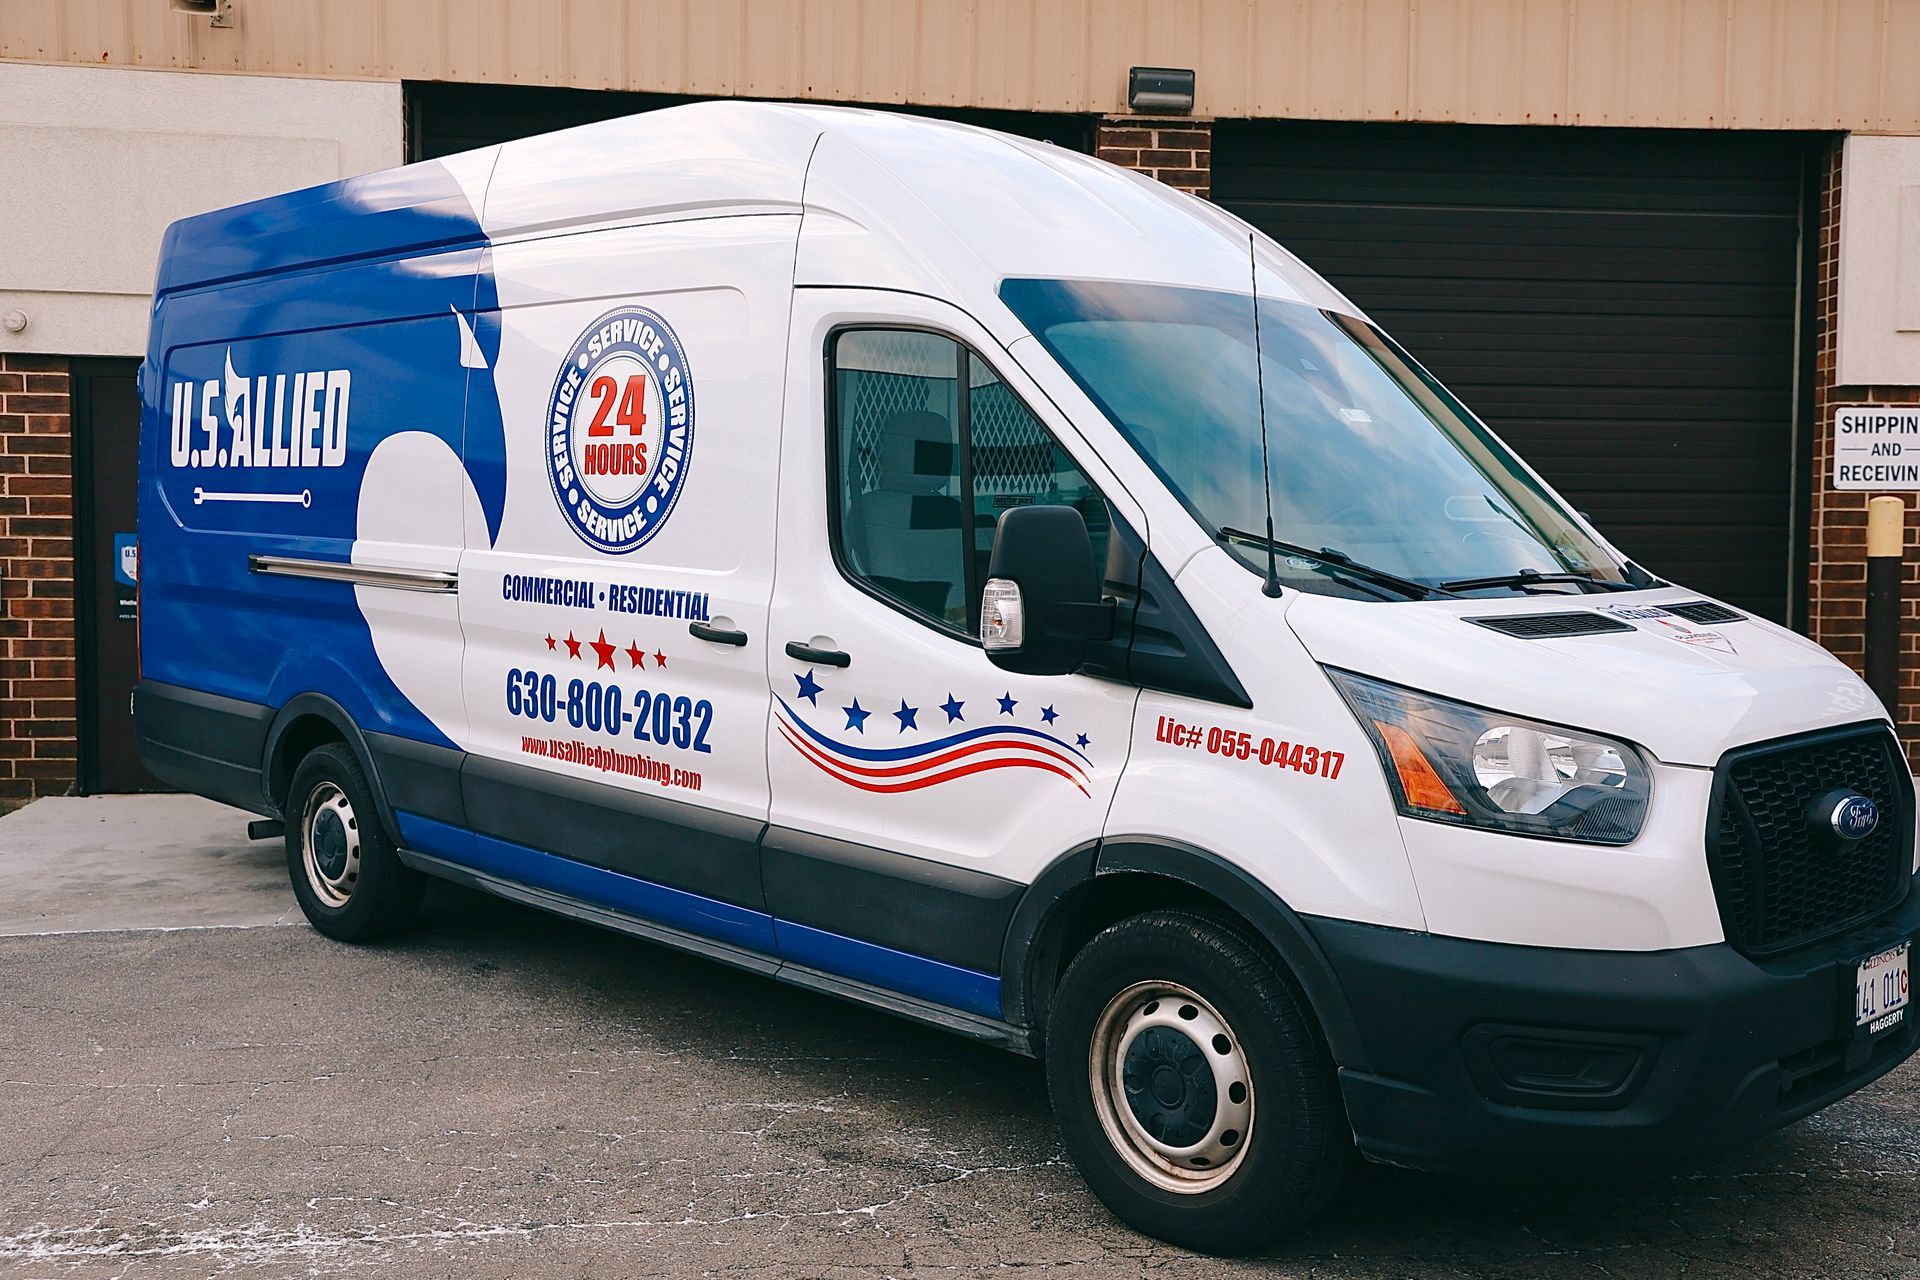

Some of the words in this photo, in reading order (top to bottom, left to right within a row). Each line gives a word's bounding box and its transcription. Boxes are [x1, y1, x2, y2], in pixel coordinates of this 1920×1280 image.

[587, 318, 664, 362] SERVICE
[225, 368, 352, 468] ALLIED
[551, 365, 582, 490] SERVICE
[588, 374, 647, 437] 24
[654, 366, 687, 498] SERVICE
[1871, 442, 1902, 456] AND
[584, 443, 647, 475] HOURS
[576, 504, 648, 542] SERVICE
[502, 573, 595, 609] COMMERCIAL
[608, 584, 711, 622] RESIDENTIAL
[506, 667, 714, 754] 630-800-2032
[521, 736, 703, 791] www.usalliedplumbing.com
[1156, 715, 1204, 750] Lic#
[1207, 726, 1345, 780] 055-044317
[1850, 805, 1874, 828] Ford
[1855, 977, 1876, 1021] 141
[1869, 1008, 1904, 1035] HAGGERTY
